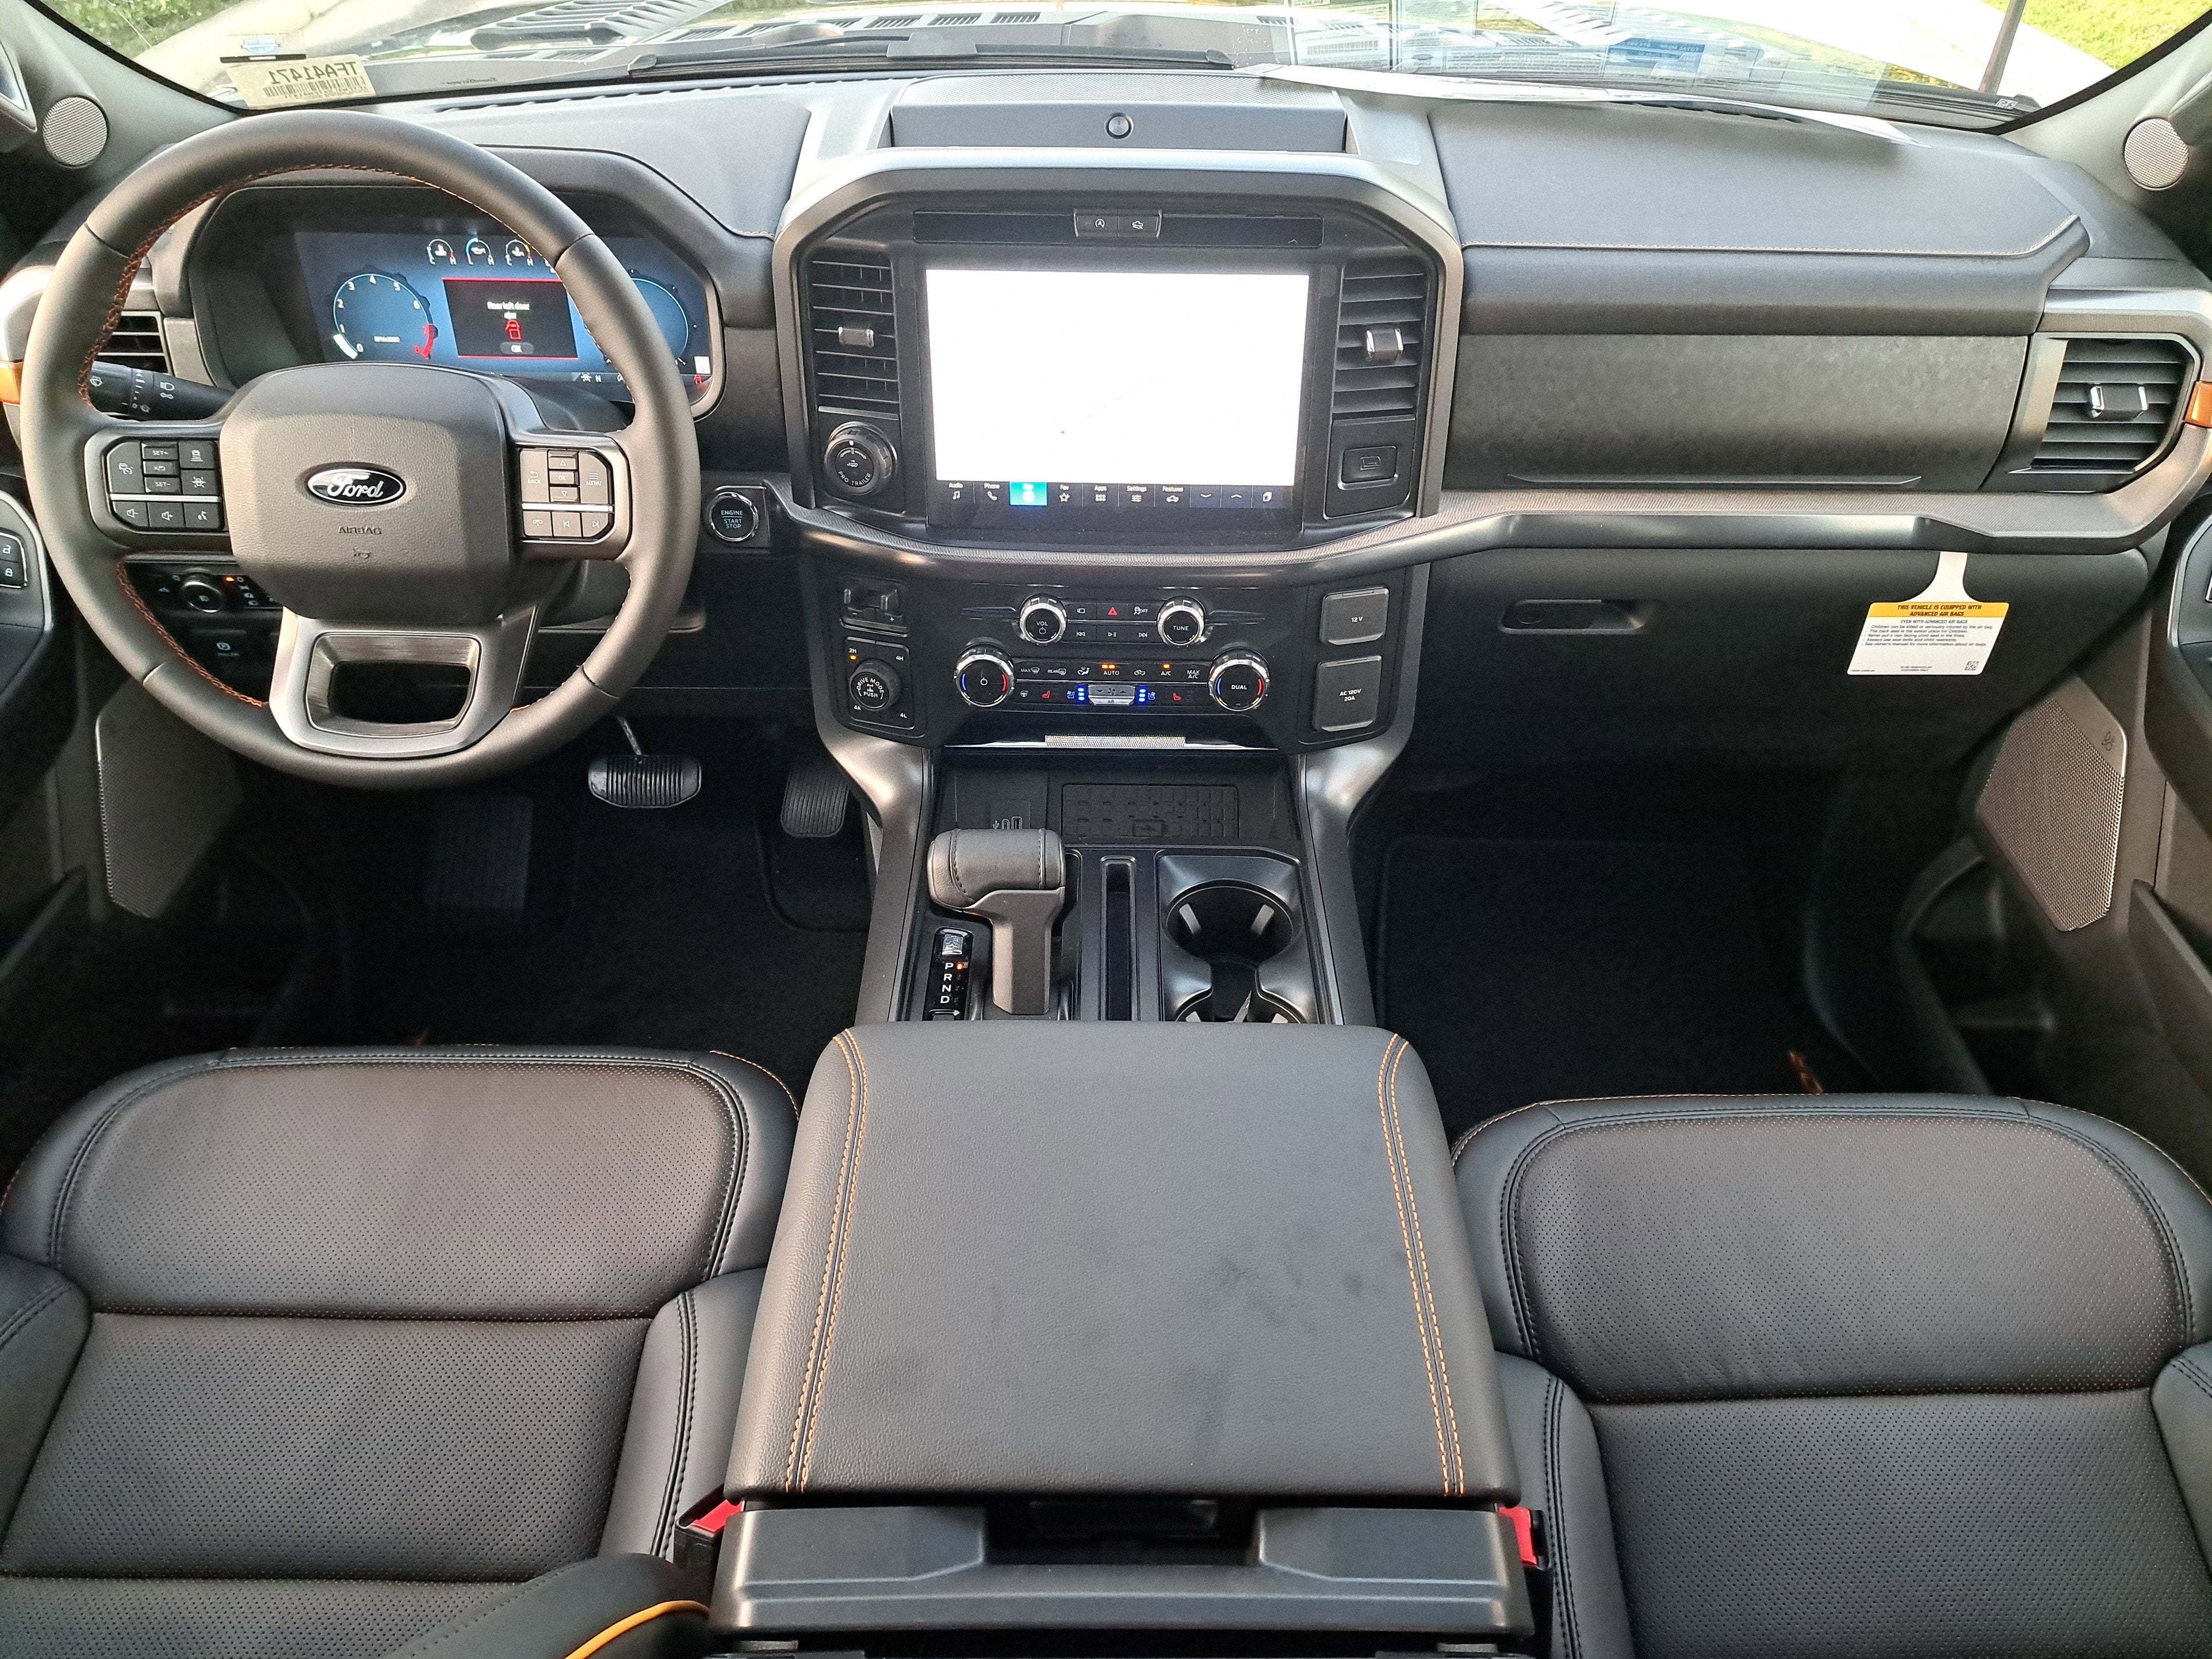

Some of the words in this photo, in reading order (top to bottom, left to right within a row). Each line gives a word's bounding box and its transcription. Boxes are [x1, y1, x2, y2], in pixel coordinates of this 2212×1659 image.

[369, 275, 376, 284] 4
[348, 281, 355, 291] 3
[394, 281, 400, 291] 5
[337, 299, 345, 309] 2
[413, 300, 420, 310] 6
[340, 324, 345, 333] 1
[422, 325, 428, 334] 7
[356, 343, 364, 353] 0
[414, 344, 420, 354] 8
[511, 344, 522, 353] OK
[838, 471, 849, 483] PRO
[852, 473, 872, 486] TRAILER
[327, 473, 384, 498] Ford
[338, 526, 382, 535] AIRBAG
[856, 677, 869, 690] DRIVE
[870, 678, 885, 694] MODE
[940, 995, 950, 1004] D
